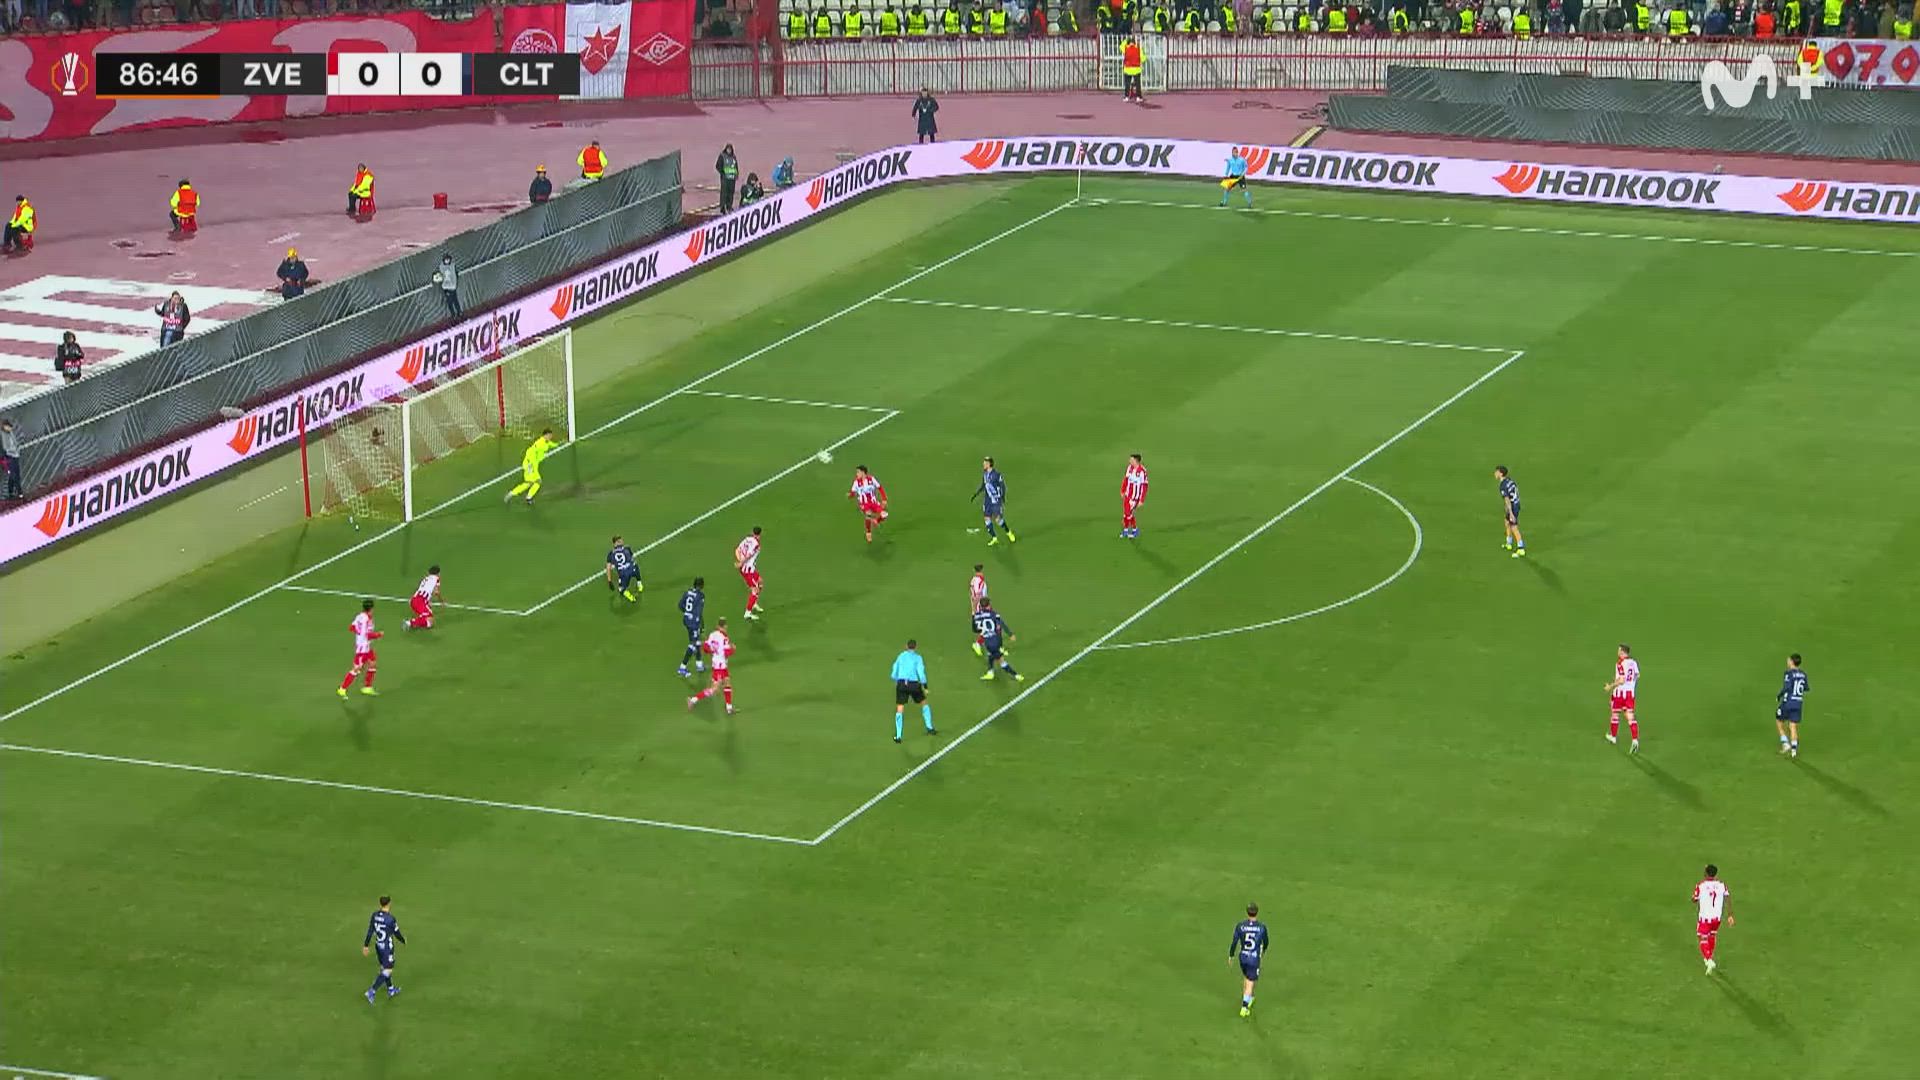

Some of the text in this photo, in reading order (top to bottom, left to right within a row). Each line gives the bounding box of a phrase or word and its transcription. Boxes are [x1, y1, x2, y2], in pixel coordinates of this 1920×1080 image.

[615, 553, 626, 565] 9
[685, 597, 693, 612] 6
[975, 618, 995, 636] 30
[1792, 679, 1805, 696] 16
[1244, 932, 1256, 950] 5
